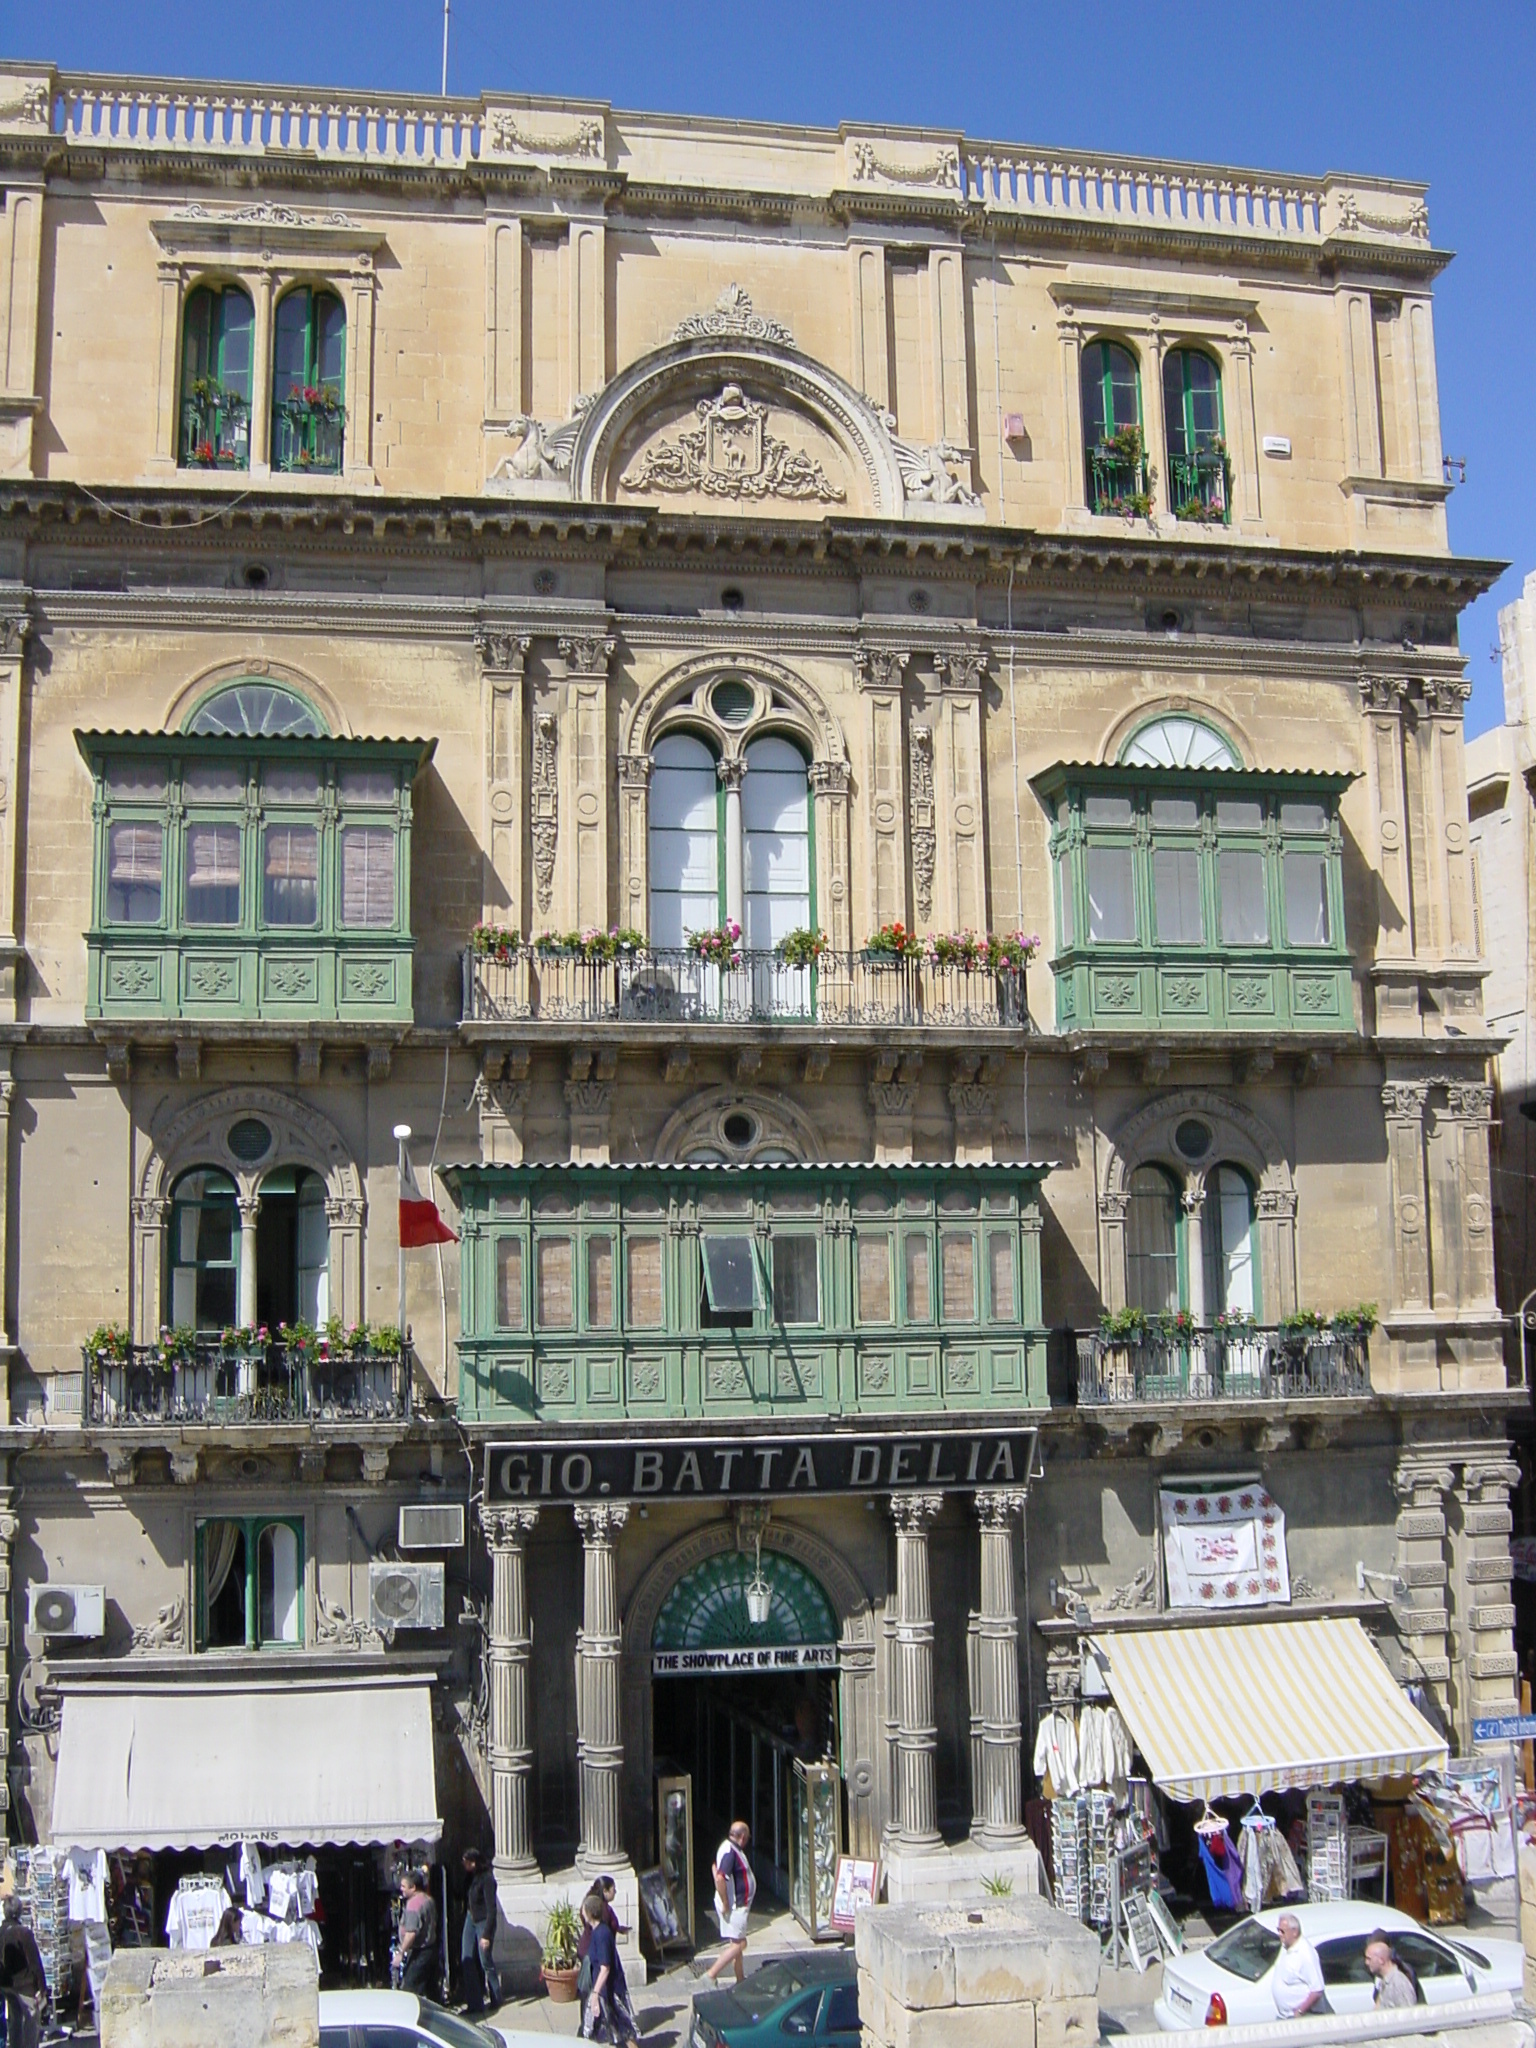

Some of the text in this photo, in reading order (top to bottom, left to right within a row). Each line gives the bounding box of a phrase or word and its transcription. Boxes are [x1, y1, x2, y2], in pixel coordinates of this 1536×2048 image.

[500, 1440, 1015, 1496] GIO. BATTA DELIA
[656, 1648, 833, 1670] THE SHOWPLACE OF FINE ARTS
